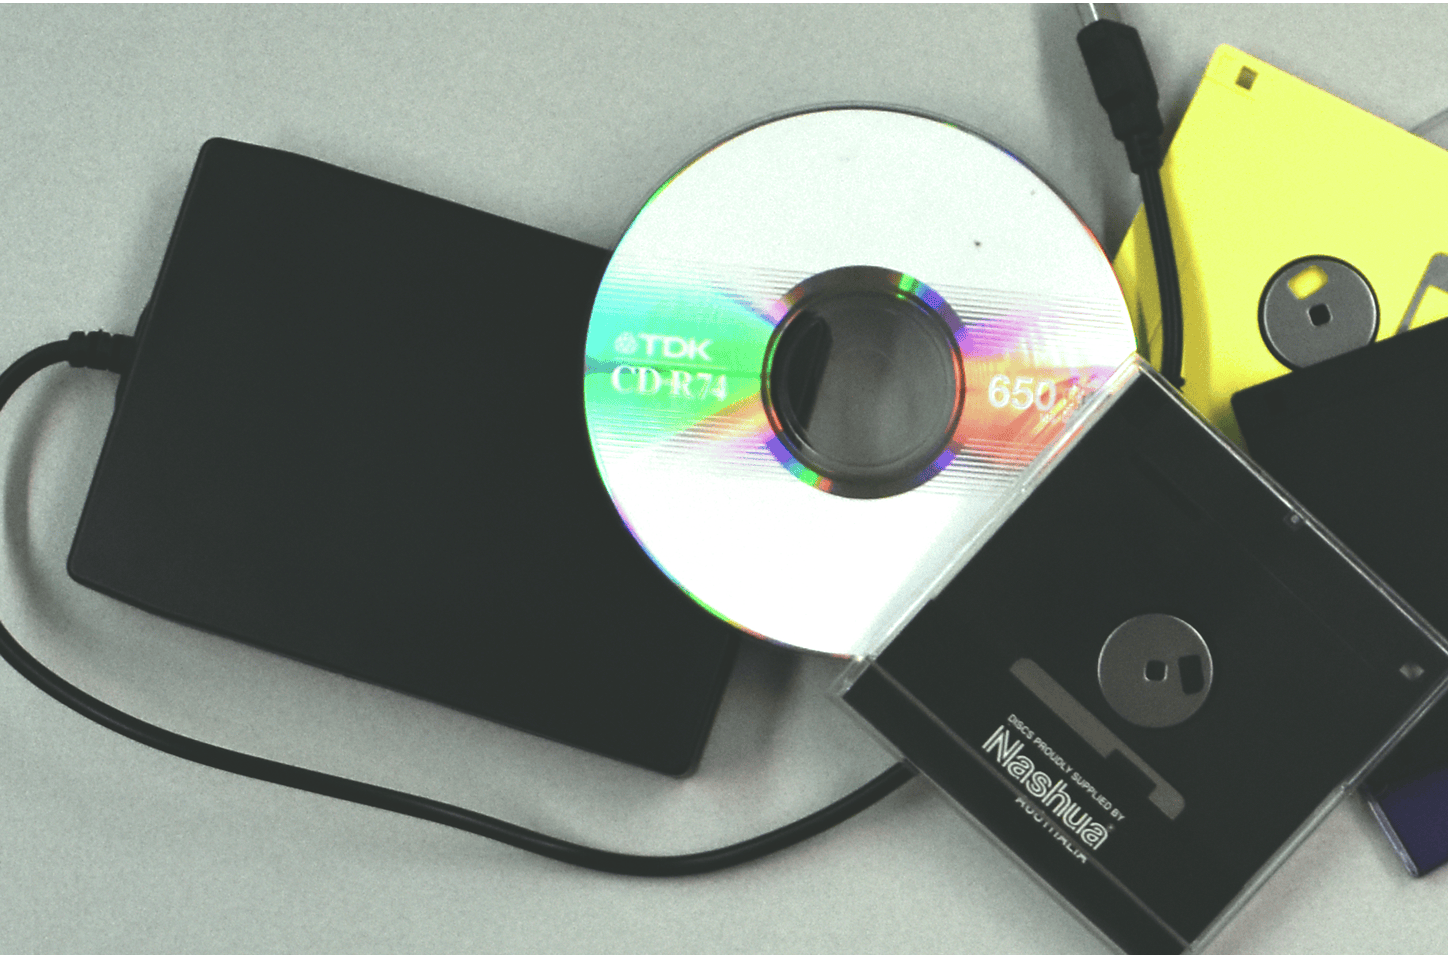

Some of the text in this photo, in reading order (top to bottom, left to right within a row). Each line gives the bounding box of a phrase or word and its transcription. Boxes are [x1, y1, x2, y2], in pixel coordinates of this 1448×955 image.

[638, 333, 713, 362] TDK
[988, 374, 1056, 411] 650
[982, 725, 1108, 850] Nashua
[1007, 713, 1125, 821] DISCS PROUDLY SUPPLIED BY
